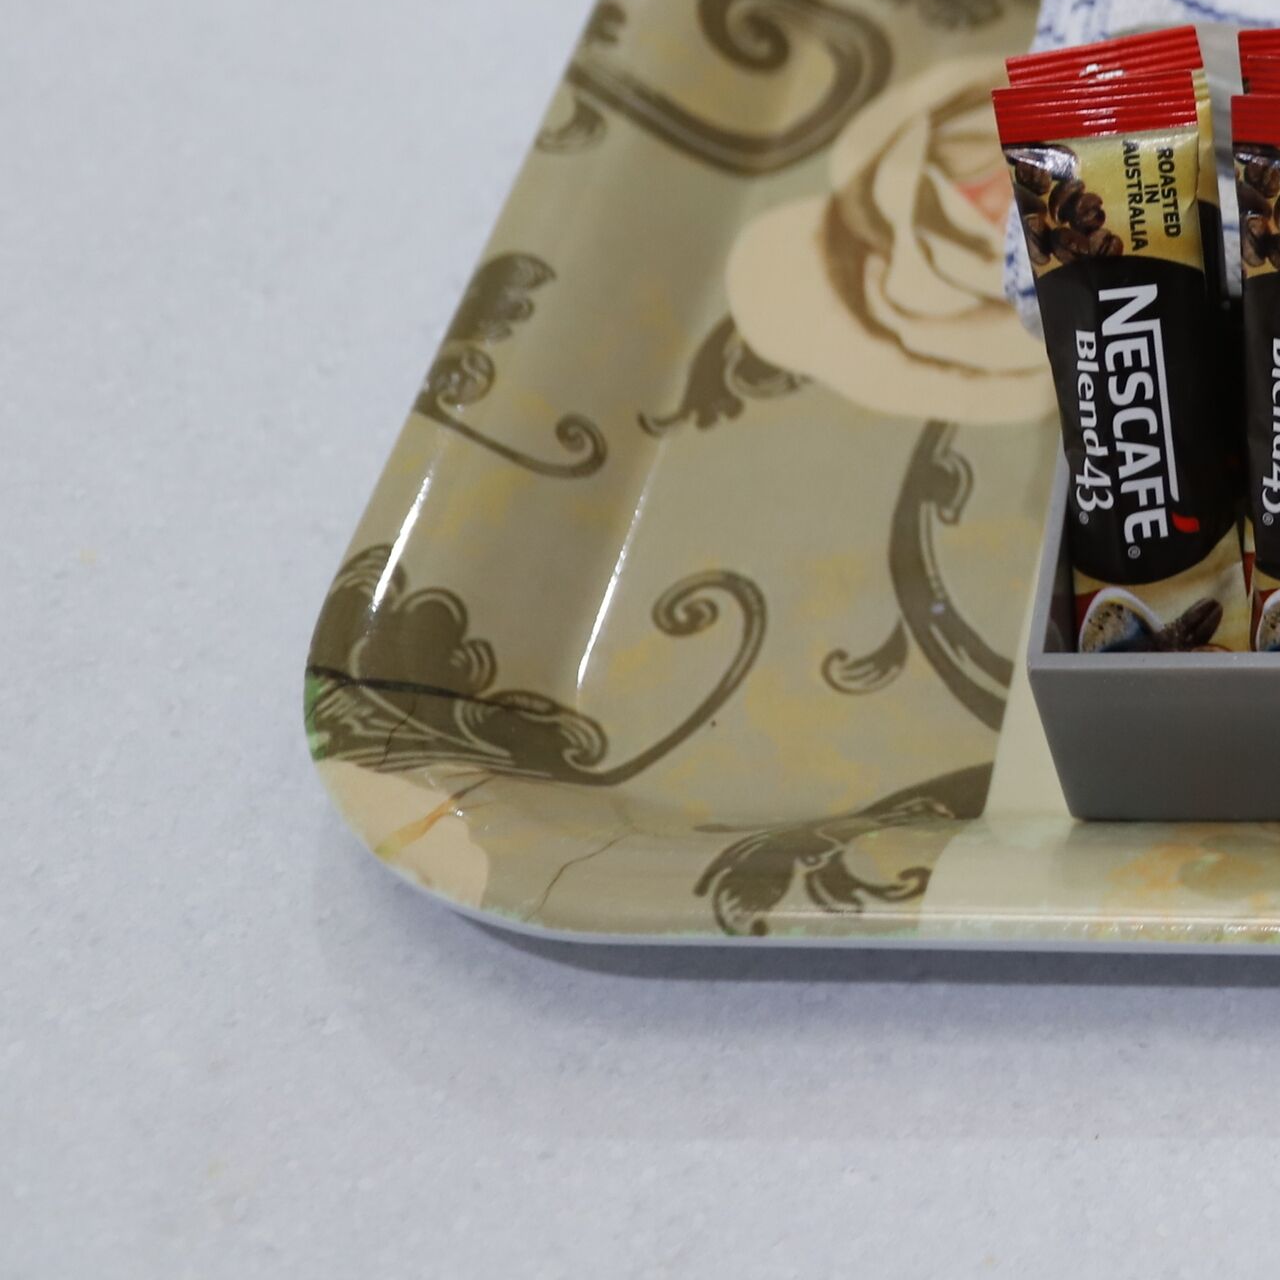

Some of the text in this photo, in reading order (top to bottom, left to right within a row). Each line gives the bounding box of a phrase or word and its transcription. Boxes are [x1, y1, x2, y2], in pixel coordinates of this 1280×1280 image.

[1122, 140, 1149, 252] AUSTRALIA
[1144, 184, 1161, 204] IN
[1156, 147, 1181, 238] ROASTED
